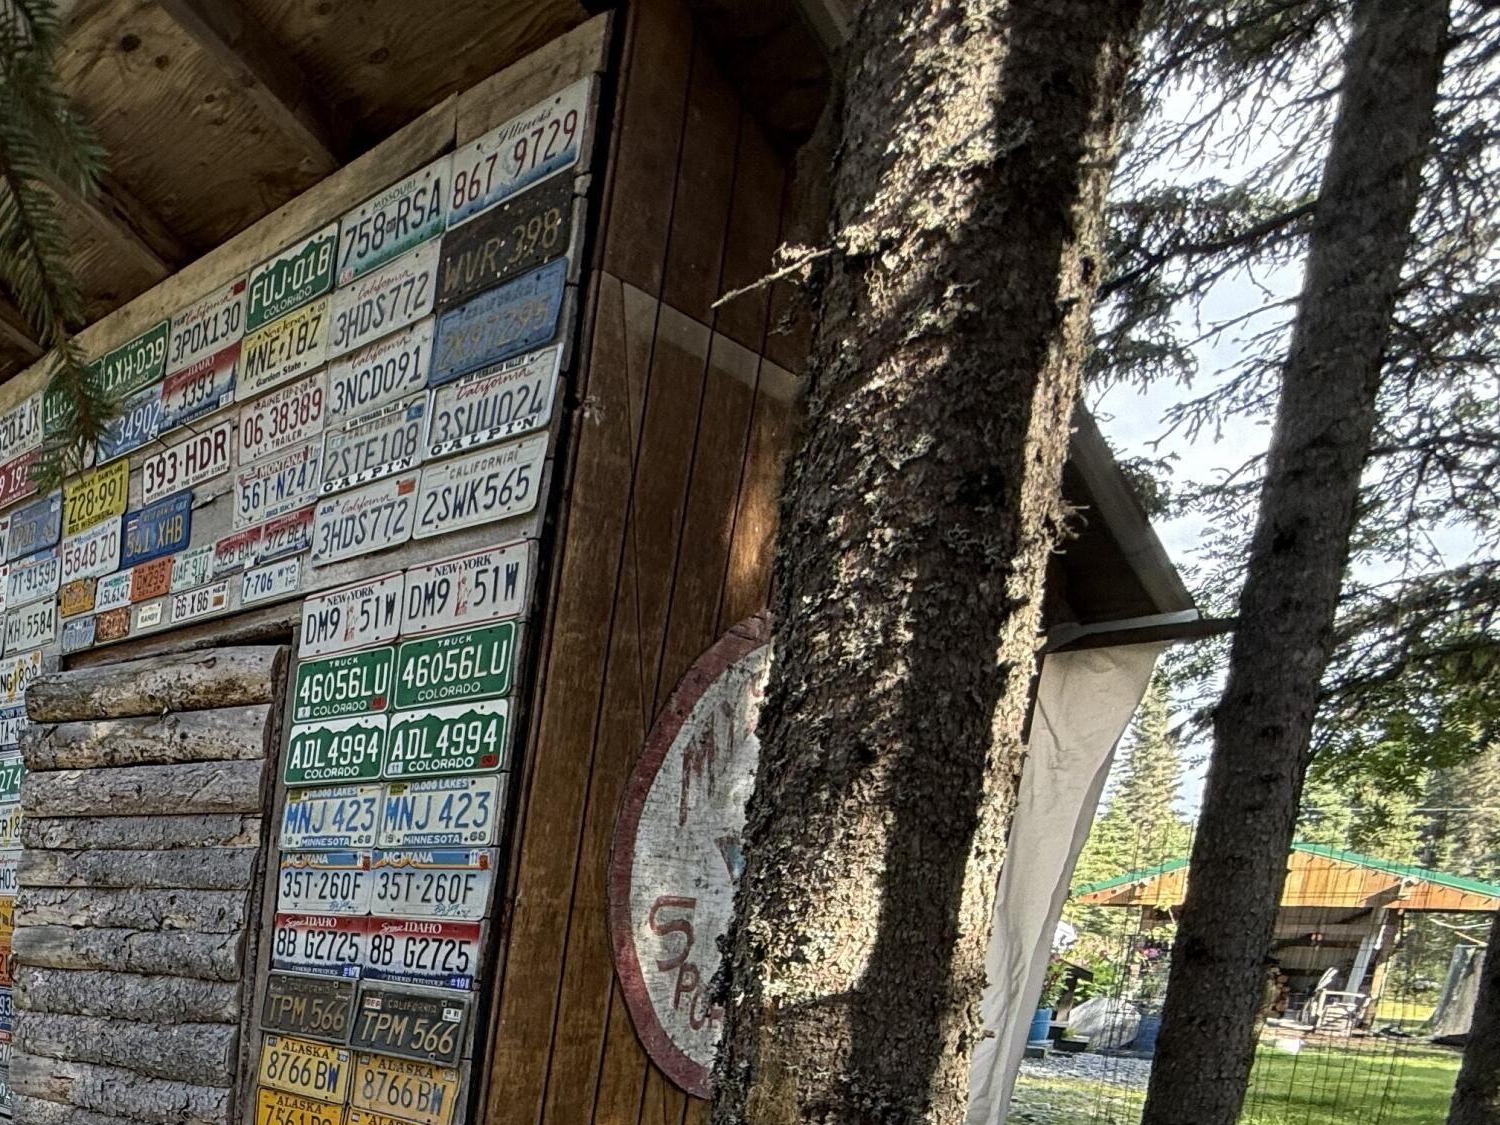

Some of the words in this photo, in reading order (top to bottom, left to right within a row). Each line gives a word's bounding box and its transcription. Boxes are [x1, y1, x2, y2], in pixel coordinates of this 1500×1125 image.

[452, 153, 498, 209] 867
[514, 109, 577, 178] 9729
[373, 179, 416, 210] MISSOURI
[342, 211, 385, 268] 758
[395, 177, 440, 240] RSA
[263, 285, 312, 320] COLORADO
[334, 271, 429, 348] 3HDS772
[179, 369, 215, 410] 3393
[256, 371, 281, 387] Garden
[283, 361, 301, 375] State
[332, 345, 421, 414] 3NCD091
[457, 368, 533, 400] California
[244, 413, 263, 449] 06
[269, 388, 322, 439] 38389
[324, 423, 419, 480] 2STE108
[450, 451, 519, 480] CALIFORNIA
[422, 465, 532, 526] 2SWK565
[319, 497, 408, 555] 3HDS772
[64, 540, 97, 577] 5848
[434, 564, 458, 578] NEW
[461, 554, 491, 571] YORK
[326, 594, 347, 607] NEW
[350, 585, 375, 601] YORK
[408, 579, 450, 620] DM9
[473, 562, 519, 606] 51W
[305, 608, 341, 646] DM9
[359, 592, 396, 632] 51W
[438, 635, 472, 648] TRUCK
[329, 657, 358, 668] TRUCK
[402, 639, 507, 690] 46056LU
[299, 662, 388, 705] 46056LU
[417, 681, 481, 701] COLORADO
[313, 701, 366, 717] COLORADO
[290, 738, 325, 769] ADL
[328, 731, 379, 766] 4994
[391, 727, 433, 761] ADL
[436, 719, 497, 756] 4994
[304, 766, 359, 780] COLORADO
[409, 756, 474, 772] COLORADO
[333, 787, 356, 796] LAKES
[439, 779, 468, 789] LAKES
[284, 801, 327, 834] MNJ
[332, 798, 376, 832] 423
[384, 795, 432, 830] MNJ
[439, 792, 491, 828] 423
[403, 835, 460, 845] MINNESOTA
[305, 917, 337, 927] IDAHO
[403, 922, 442, 934] IDAHO
[277, 928, 297, 957] 8B
[370, 934, 395, 966] 8B
[361, 1011, 408, 1047] TPM
[411, 1018, 459, 1055] 566
[283, 1041, 329, 1060] ALASKA
[267, 1051, 311, 1087] 8766
[314, 1061, 341, 1093] BW
[377, 1060, 434, 1079] ALASKA
[276, 1095, 322, 1115] ALASKA
[362, 1069, 413, 1108] 8766
